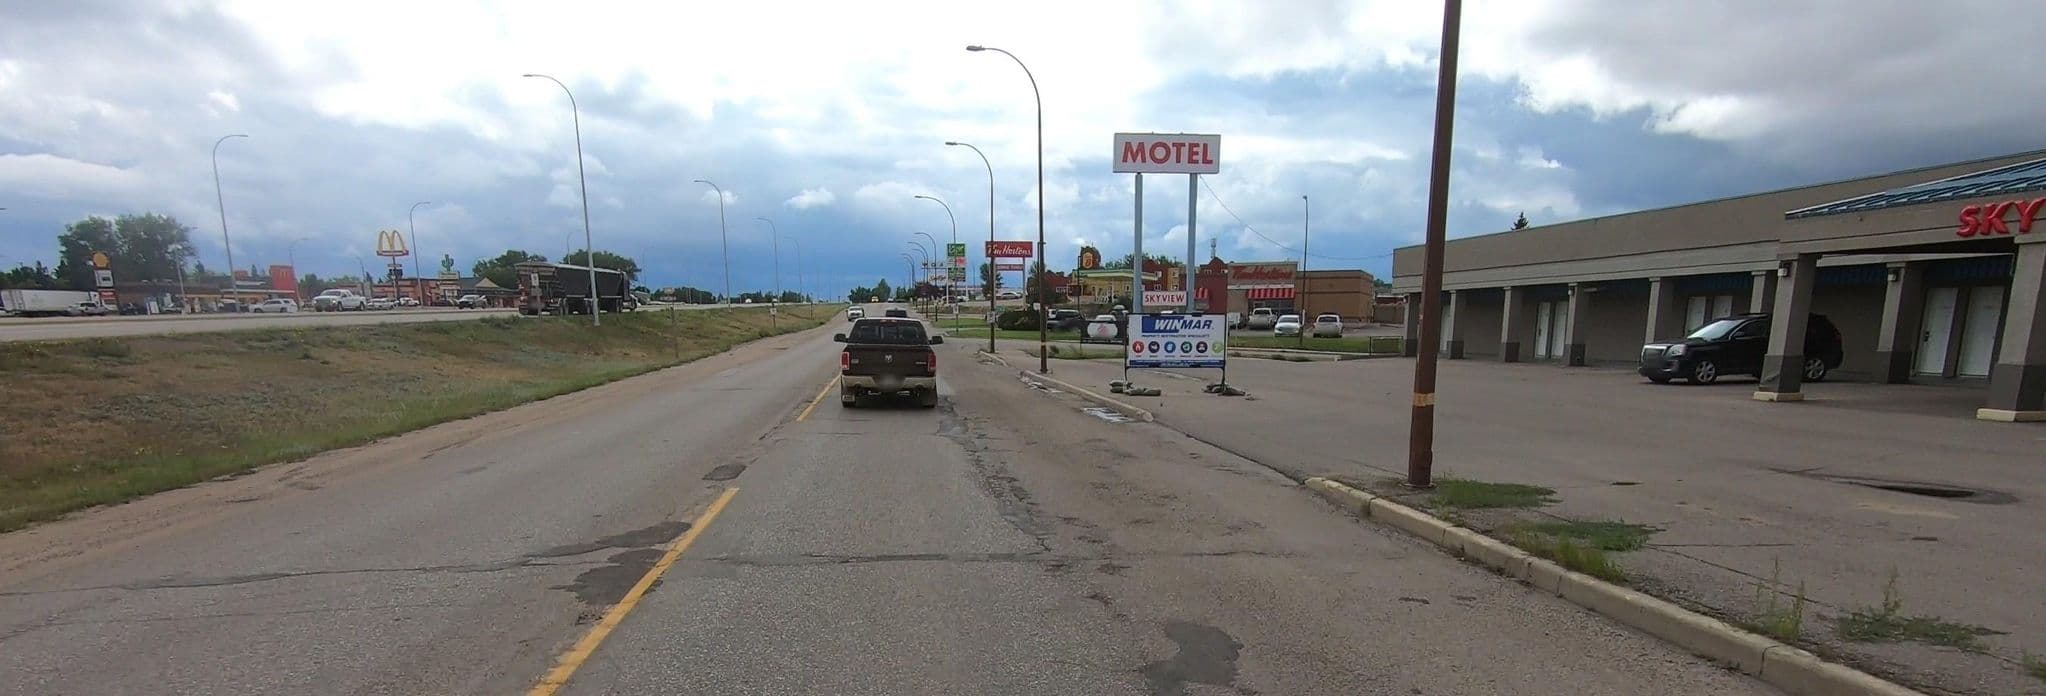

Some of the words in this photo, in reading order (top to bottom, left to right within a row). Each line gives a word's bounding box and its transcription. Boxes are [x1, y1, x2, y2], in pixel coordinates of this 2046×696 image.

[1122, 141, 1213, 164] MOTEL
[1957, 198, 2046, 236] SKY
[1002, 243, 1031, 256] Hortons
[1144, 292, 1185, 303] SKYVIEW
[1154, 319, 1213, 330] WINMAR
